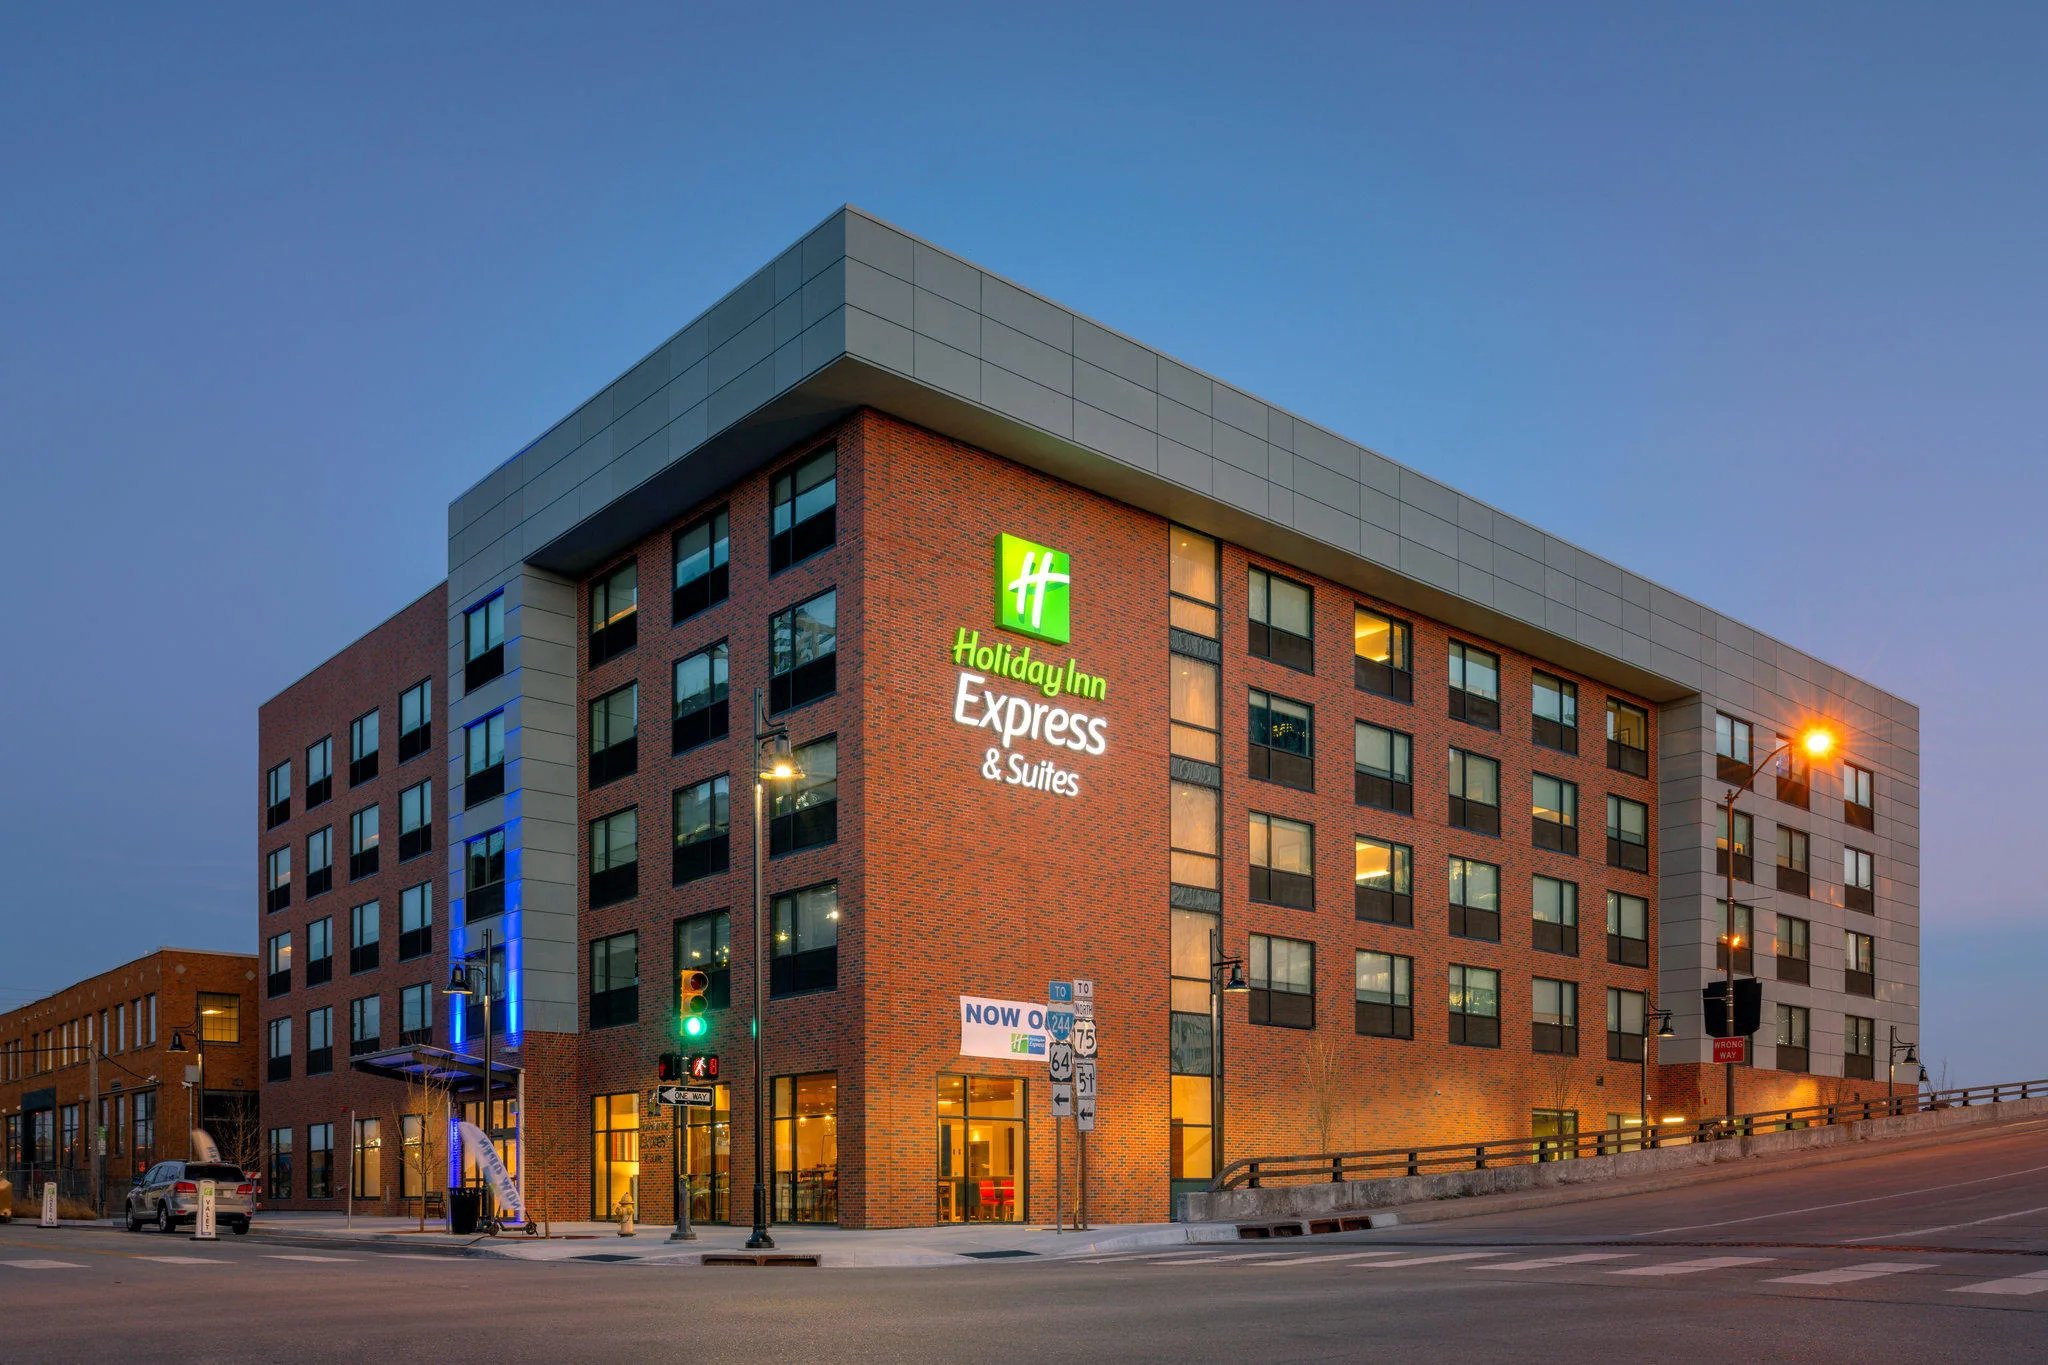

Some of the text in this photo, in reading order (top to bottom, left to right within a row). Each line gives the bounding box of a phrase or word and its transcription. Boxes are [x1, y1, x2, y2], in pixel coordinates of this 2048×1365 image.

[953, 627, 1107, 700] Holiday Inn
[953, 672, 1107, 755] Express
[982, 748, 1080, 796] & Suites
[1055, 985, 1066, 997] TO
[1078, 982, 1089, 994] TO
[966, 1003, 1020, 1028] NOW
[1075, 1003, 1093, 1015] NORTH
[1051, 1015, 1071, 1034] 244
[1076, 1029, 1095, 1049] 75
[1714, 1040, 1744, 1049] WRONG
[1051, 1051, 1070, 1072] 64
[1720, 1051, 1737, 1060] WAY
[1079, 1073, 1093, 1093] 51
[675, 1092, 707, 1101] ONE WAY
